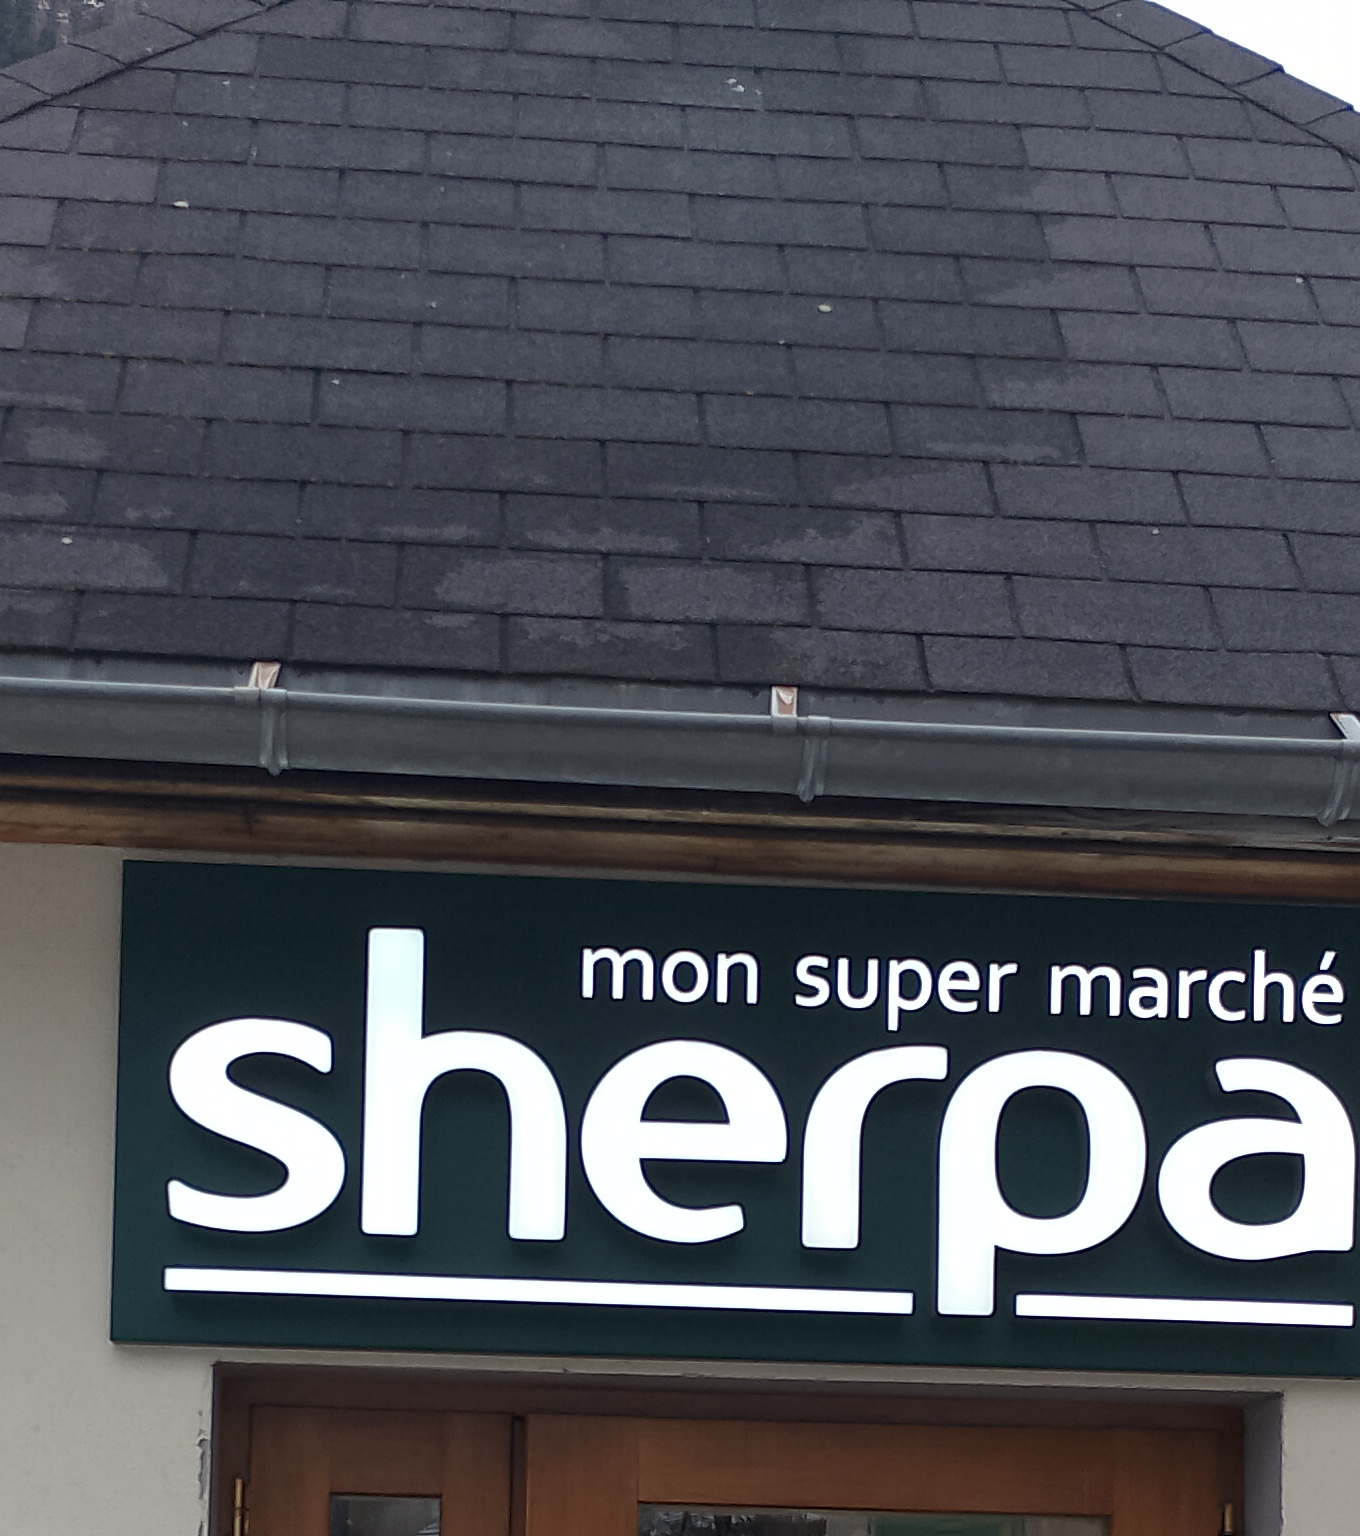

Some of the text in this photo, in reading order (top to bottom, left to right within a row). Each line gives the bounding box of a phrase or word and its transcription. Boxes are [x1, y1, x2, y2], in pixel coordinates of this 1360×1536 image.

[581, 947, 1344, 1032] mon super marché
[165, 927, 1357, 1318] sherpa
